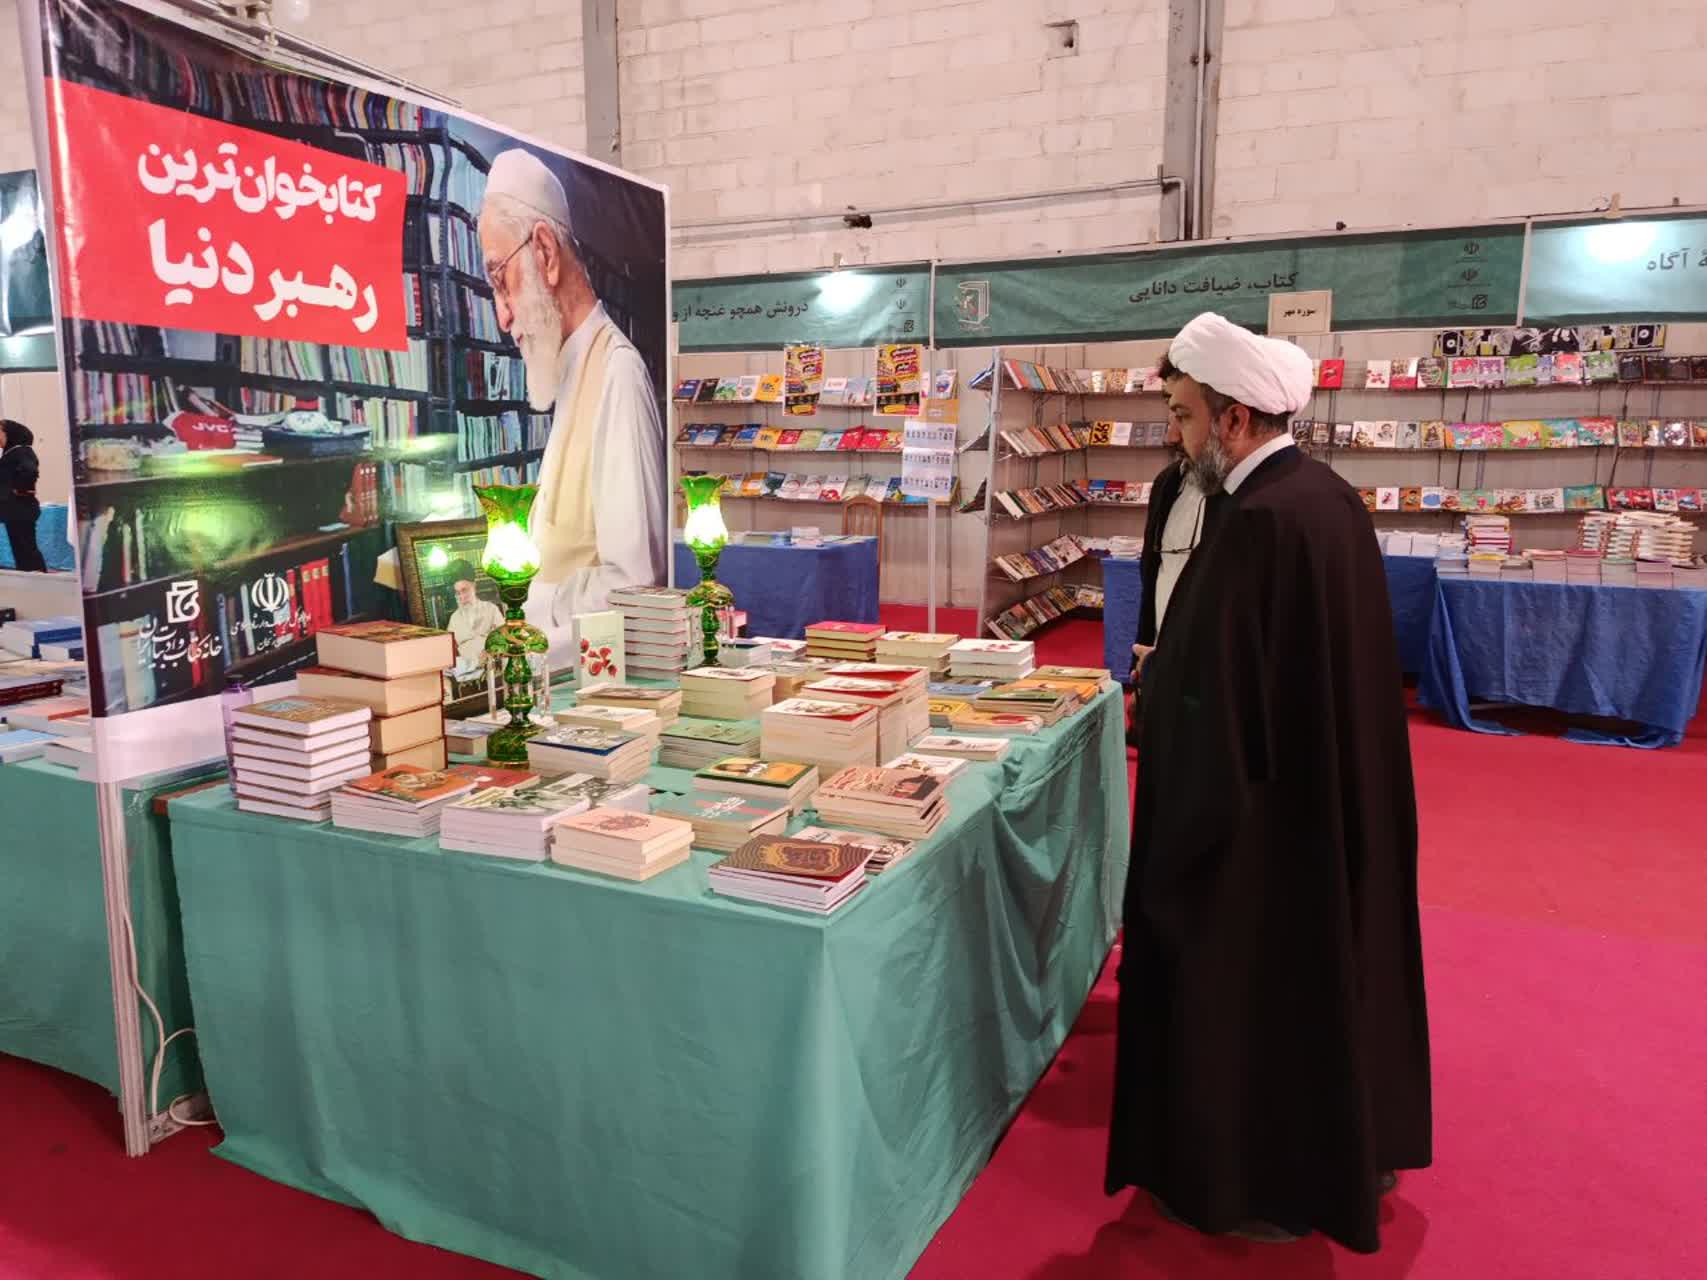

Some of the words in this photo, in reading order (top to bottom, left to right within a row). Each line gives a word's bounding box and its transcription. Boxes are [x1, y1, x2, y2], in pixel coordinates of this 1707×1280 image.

[147, 218, 255, 306] دنیا
[1647, 247, 1691, 270] آگاه
[1129, 281, 1177, 302] دانایی
[1183, 277, 1241, 296] ضیافت
[254, 264, 379, 333] رهبر
[695, 303, 726, 320] غنچه
[730, 304, 762, 319] همچو
[767, 301, 808, 318] درونش
[192, 422, 229, 432] JVC
[201, 635, 223, 660] خانه
